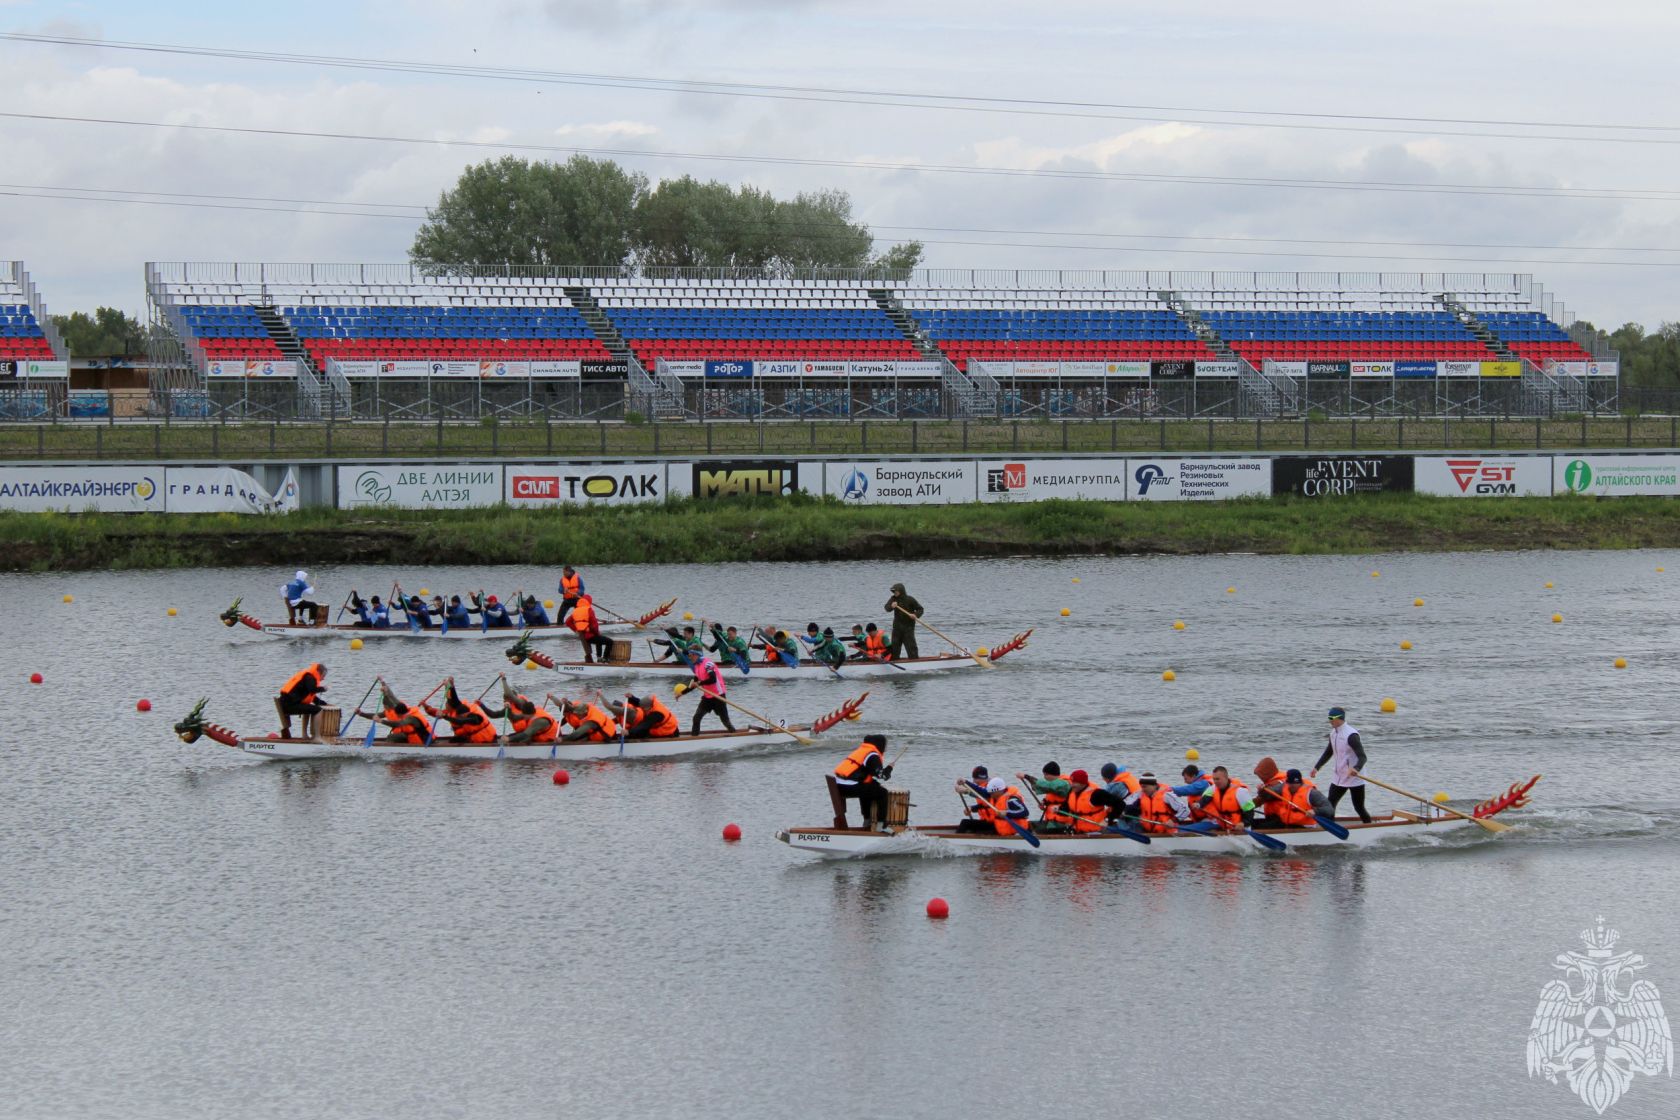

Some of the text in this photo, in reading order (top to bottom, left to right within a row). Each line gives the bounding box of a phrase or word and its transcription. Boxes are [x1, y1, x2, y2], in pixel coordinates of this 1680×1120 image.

[770, 364, 797, 373] АЗПИ
[851, 364, 894, 374] Катунь 24
[1180, 463, 1261, 471] Барнаульский завод
[1306, 460, 1382, 479] life EVENT
[397, 472, 494, 485] ДВЕ ЛИНИИ
[876, 467, 963, 484] Барнаульский
[1033, 475, 1121, 486] МЕДИАГРУППА
[1595, 473, 1677, 486] АЛТАЙСКОГО КРАЯ
[564, 474, 658, 498] ТОЛК
[1180, 480, 1229, 488] Технических
[1303, 478, 1353, 496] CORP
[1476, 483, 1516, 494] GYM
[169, 485, 234, 496] ГРАНД
[421, 489, 470, 501] АЛТЭЯ
[876, 483, 941, 498] завод АТИ
[1180, 489, 1215, 497] Изделий
